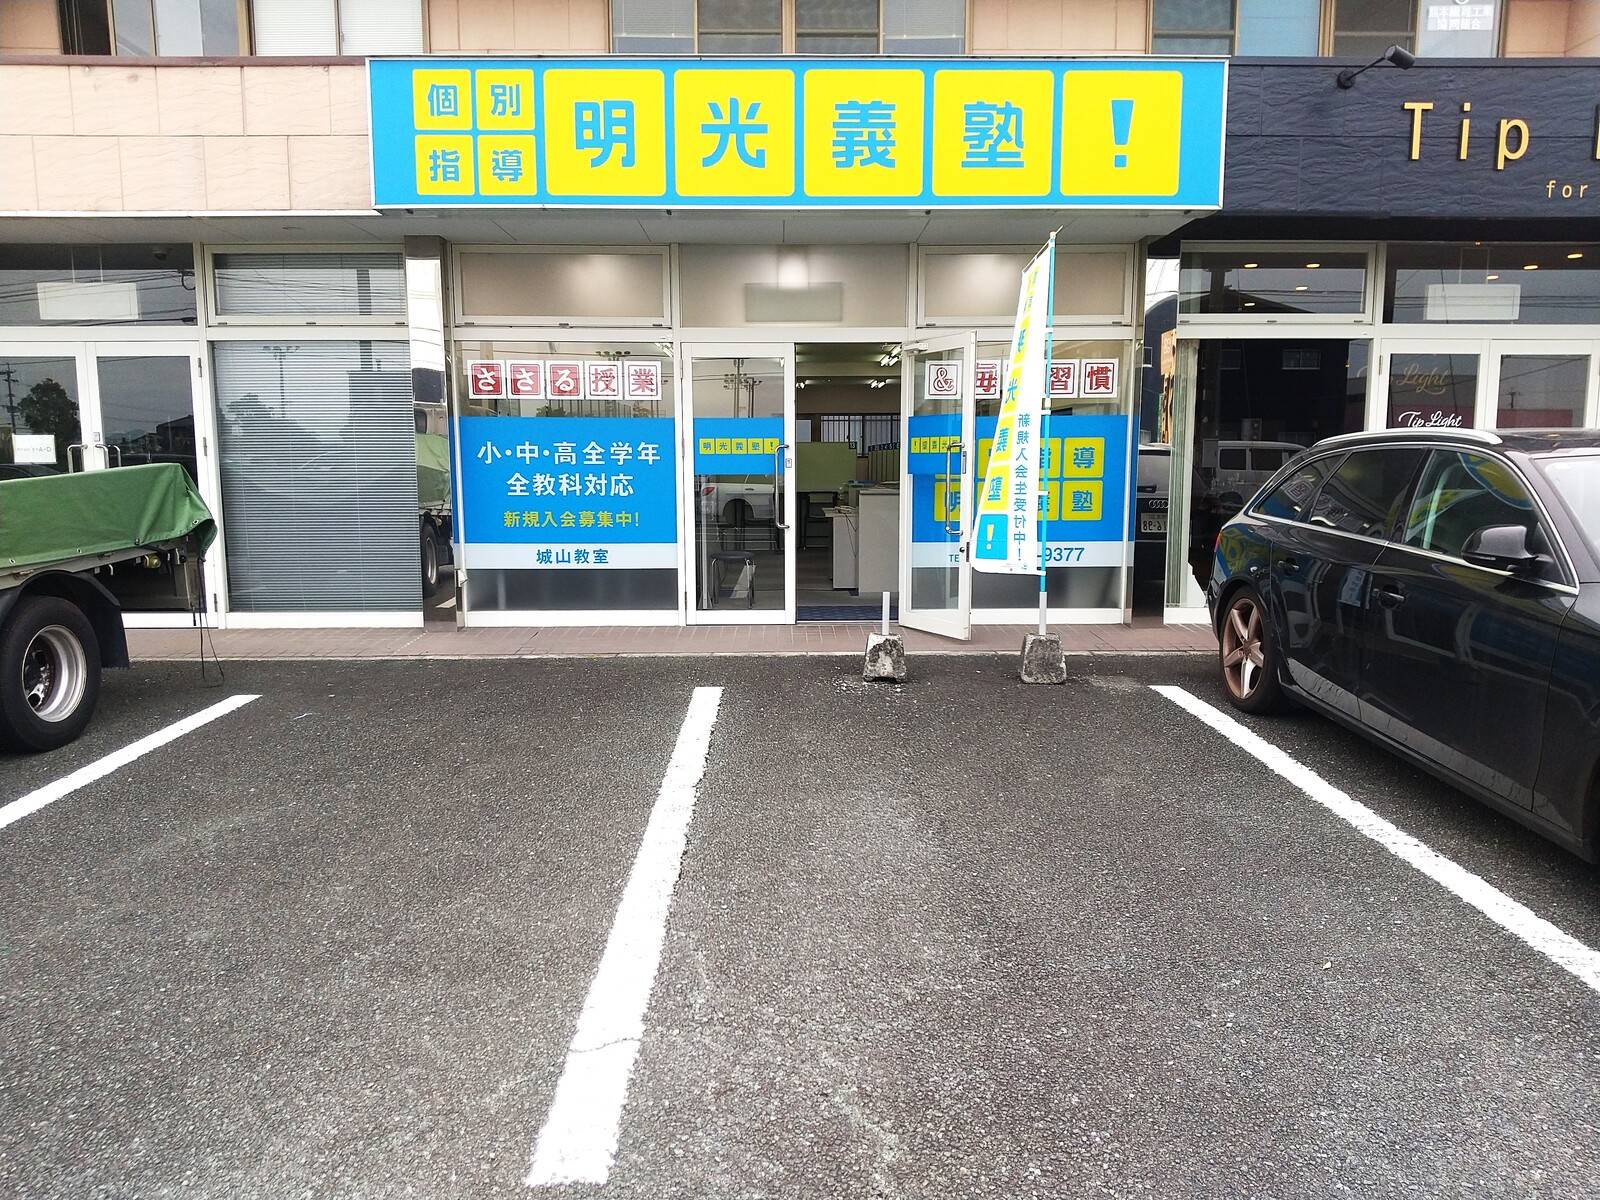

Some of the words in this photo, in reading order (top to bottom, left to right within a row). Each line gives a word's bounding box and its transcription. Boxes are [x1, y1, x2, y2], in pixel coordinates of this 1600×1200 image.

[427, 83, 521, 117] 個別
[574, 97, 1135, 169] 明光義塾!
[1403, 102, 1530, 171] Tip
[428, 149, 523, 182] 指導
[1546, 180, 1588, 198] for
[477, 367, 656, 393] ささる授業
[1396, 363, 1449, 395] Light
[1398, 411, 1425, 427] Tip
[1425, 410, 1462, 427] Light
[506, 472, 635, 497] 全教科対応
[503, 511, 640, 528] 新規入会募集中!
[536, 549, 609, 565] 城山教室
